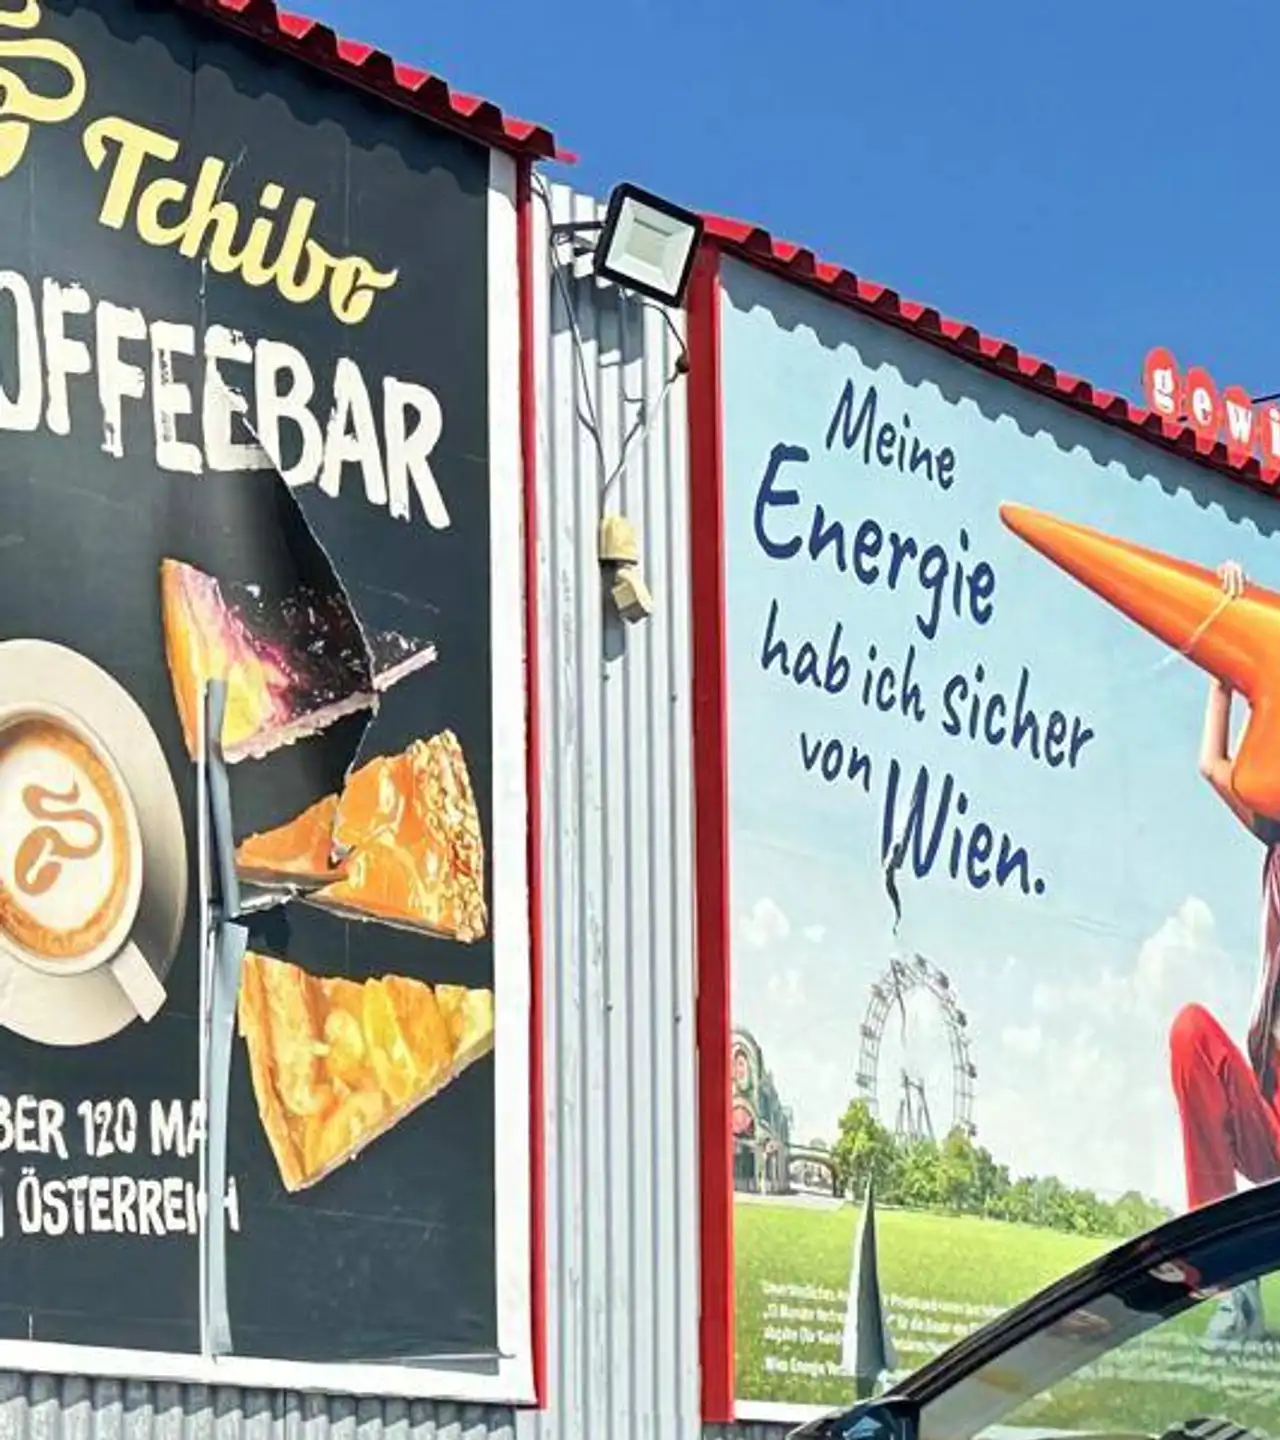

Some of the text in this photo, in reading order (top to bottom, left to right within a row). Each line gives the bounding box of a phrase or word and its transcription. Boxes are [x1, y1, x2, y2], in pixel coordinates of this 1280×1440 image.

[82, 115, 399, 325] Tchibo
[825, 377, 956, 491] Meine
[753, 441, 996, 640] Energie
[761, 598, 1096, 770] hab ich sicher
[799, 731, 1047, 896] von Wien.
[77, 1097, 138, 1158] 120
